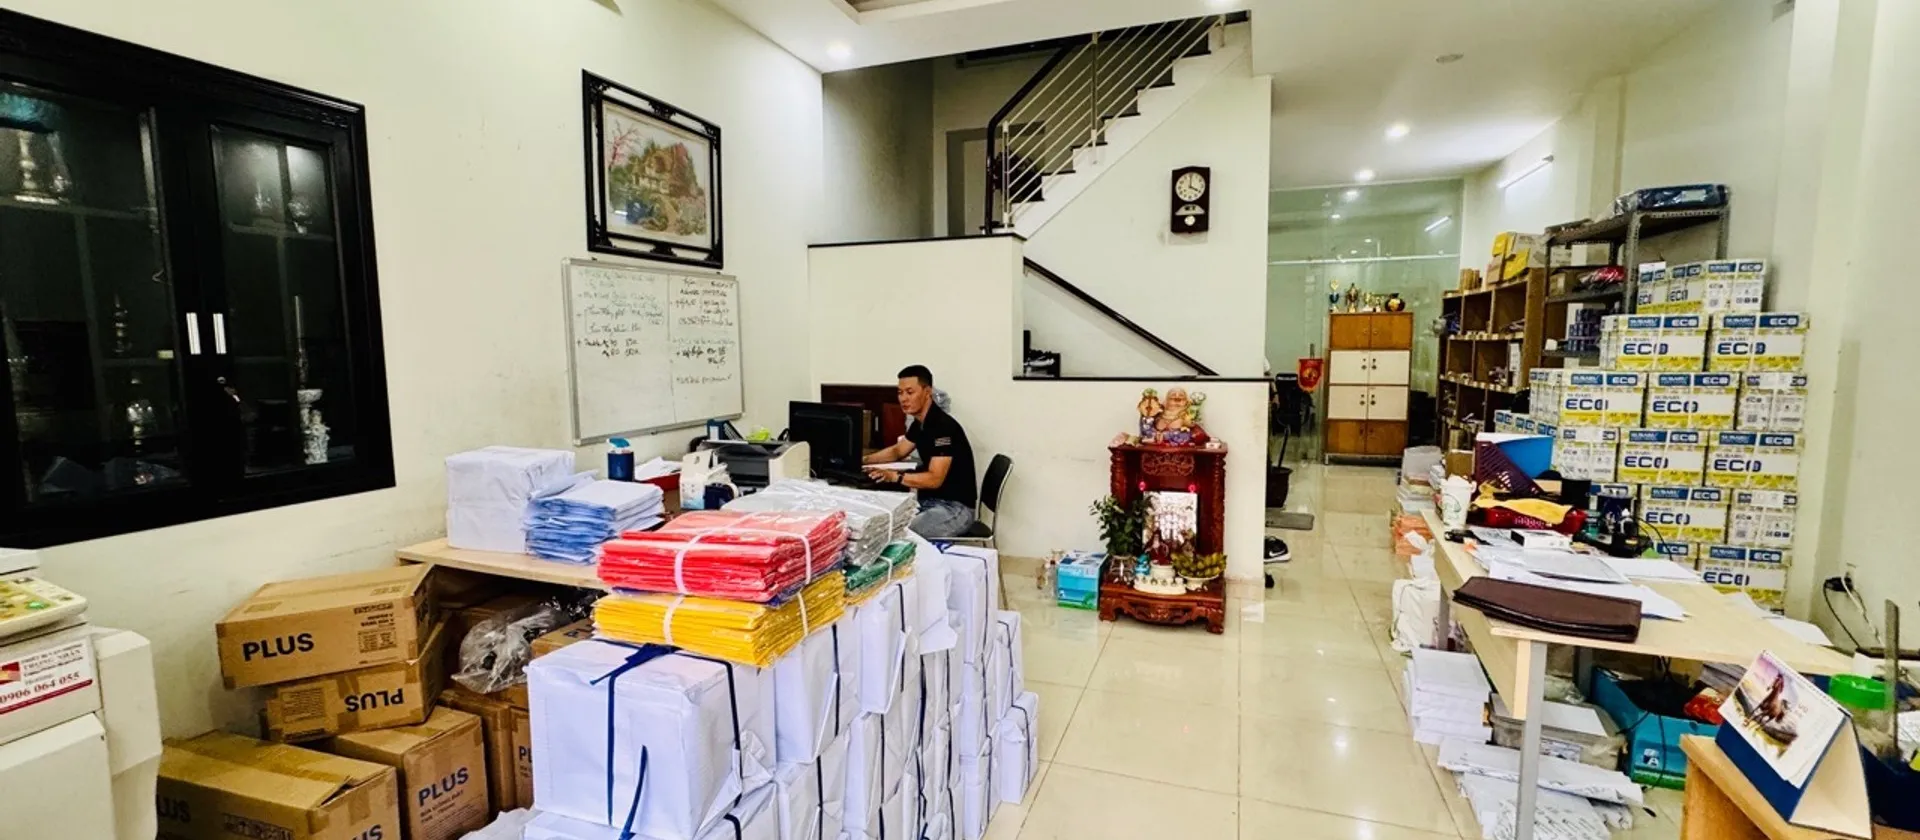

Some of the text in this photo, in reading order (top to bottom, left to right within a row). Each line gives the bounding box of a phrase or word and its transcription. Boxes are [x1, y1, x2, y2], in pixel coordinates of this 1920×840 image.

[1671, 318, 1698, 327] ECO
[1769, 317, 1798, 326] ECO
[1623, 343, 1669, 355] ECO
[1717, 342, 1766, 355] ECO
[1612, 376, 1637, 385] ECO
[1702, 376, 1729, 385] ECO
[1565, 398, 1609, 411] ECO
[1652, 400, 1699, 413] ECO
[1671, 433, 1697, 441] ECO
[1764, 435, 1793, 445] ECO
[1624, 456, 1669, 469] ECO
[1714, 459, 1762, 472] ECO
[1645, 511, 1690, 525] ECO
[1753, 551, 1780, 561] ECO
[1702, 571, 1751, 586] ECO
[242, 632, 315, 662] PLUS
[0, 689, 31, 703] 0906
[34, 680, 56, 693] 064
[58, 671, 80, 684] 055
[344, 688, 404, 712] PLUS
[518, 745, 533, 763] PL
[418, 766, 469, 807] PLUS
